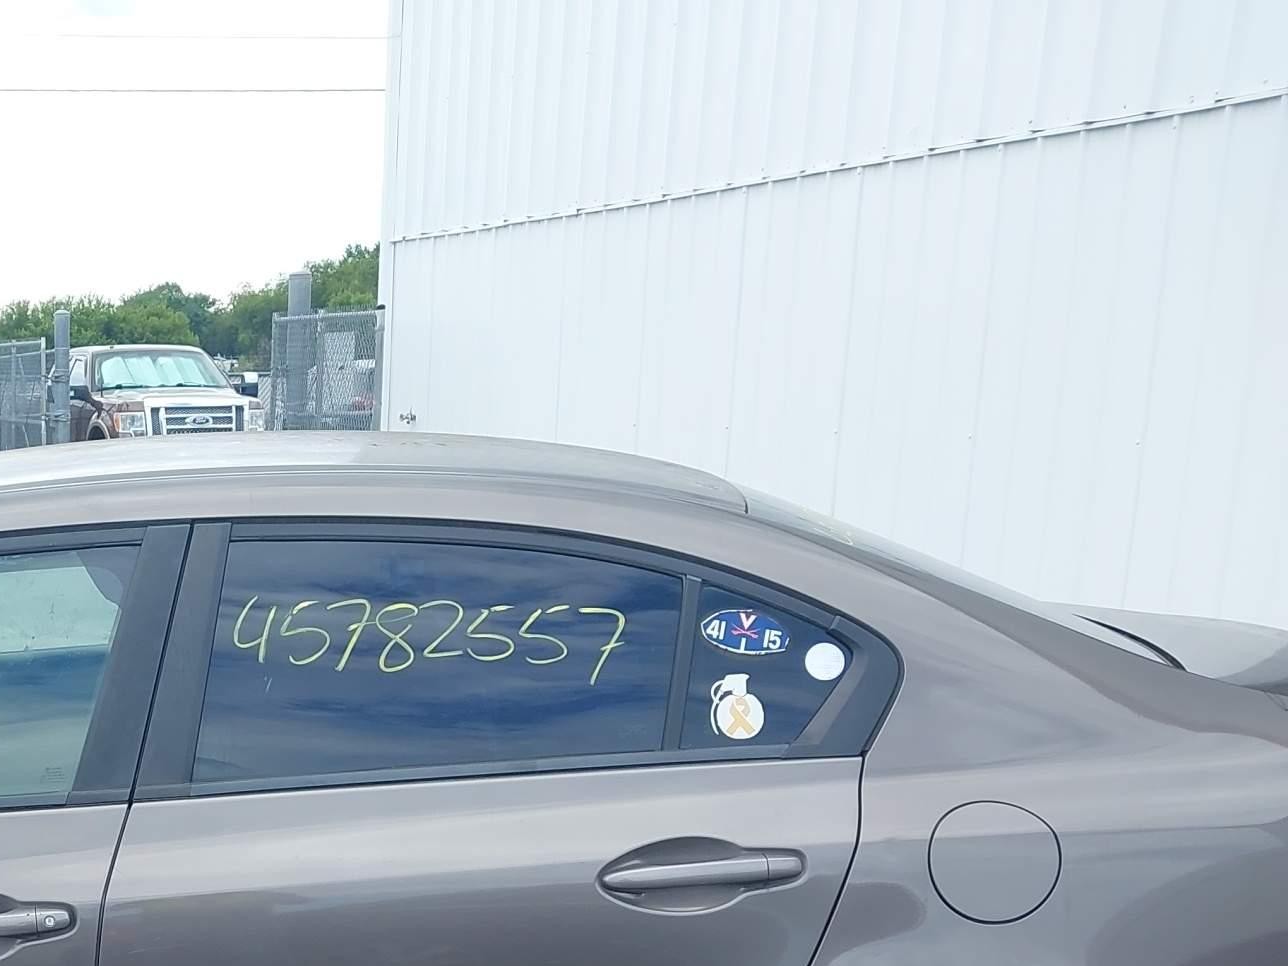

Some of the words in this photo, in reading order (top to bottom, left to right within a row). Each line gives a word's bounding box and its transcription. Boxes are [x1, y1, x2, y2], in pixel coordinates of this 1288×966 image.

[705, 619, 727, 641] 41
[739, 612, 758, 630] V
[233, 595, 627, 686] 45782557
[762, 628, 783, 650] 15
